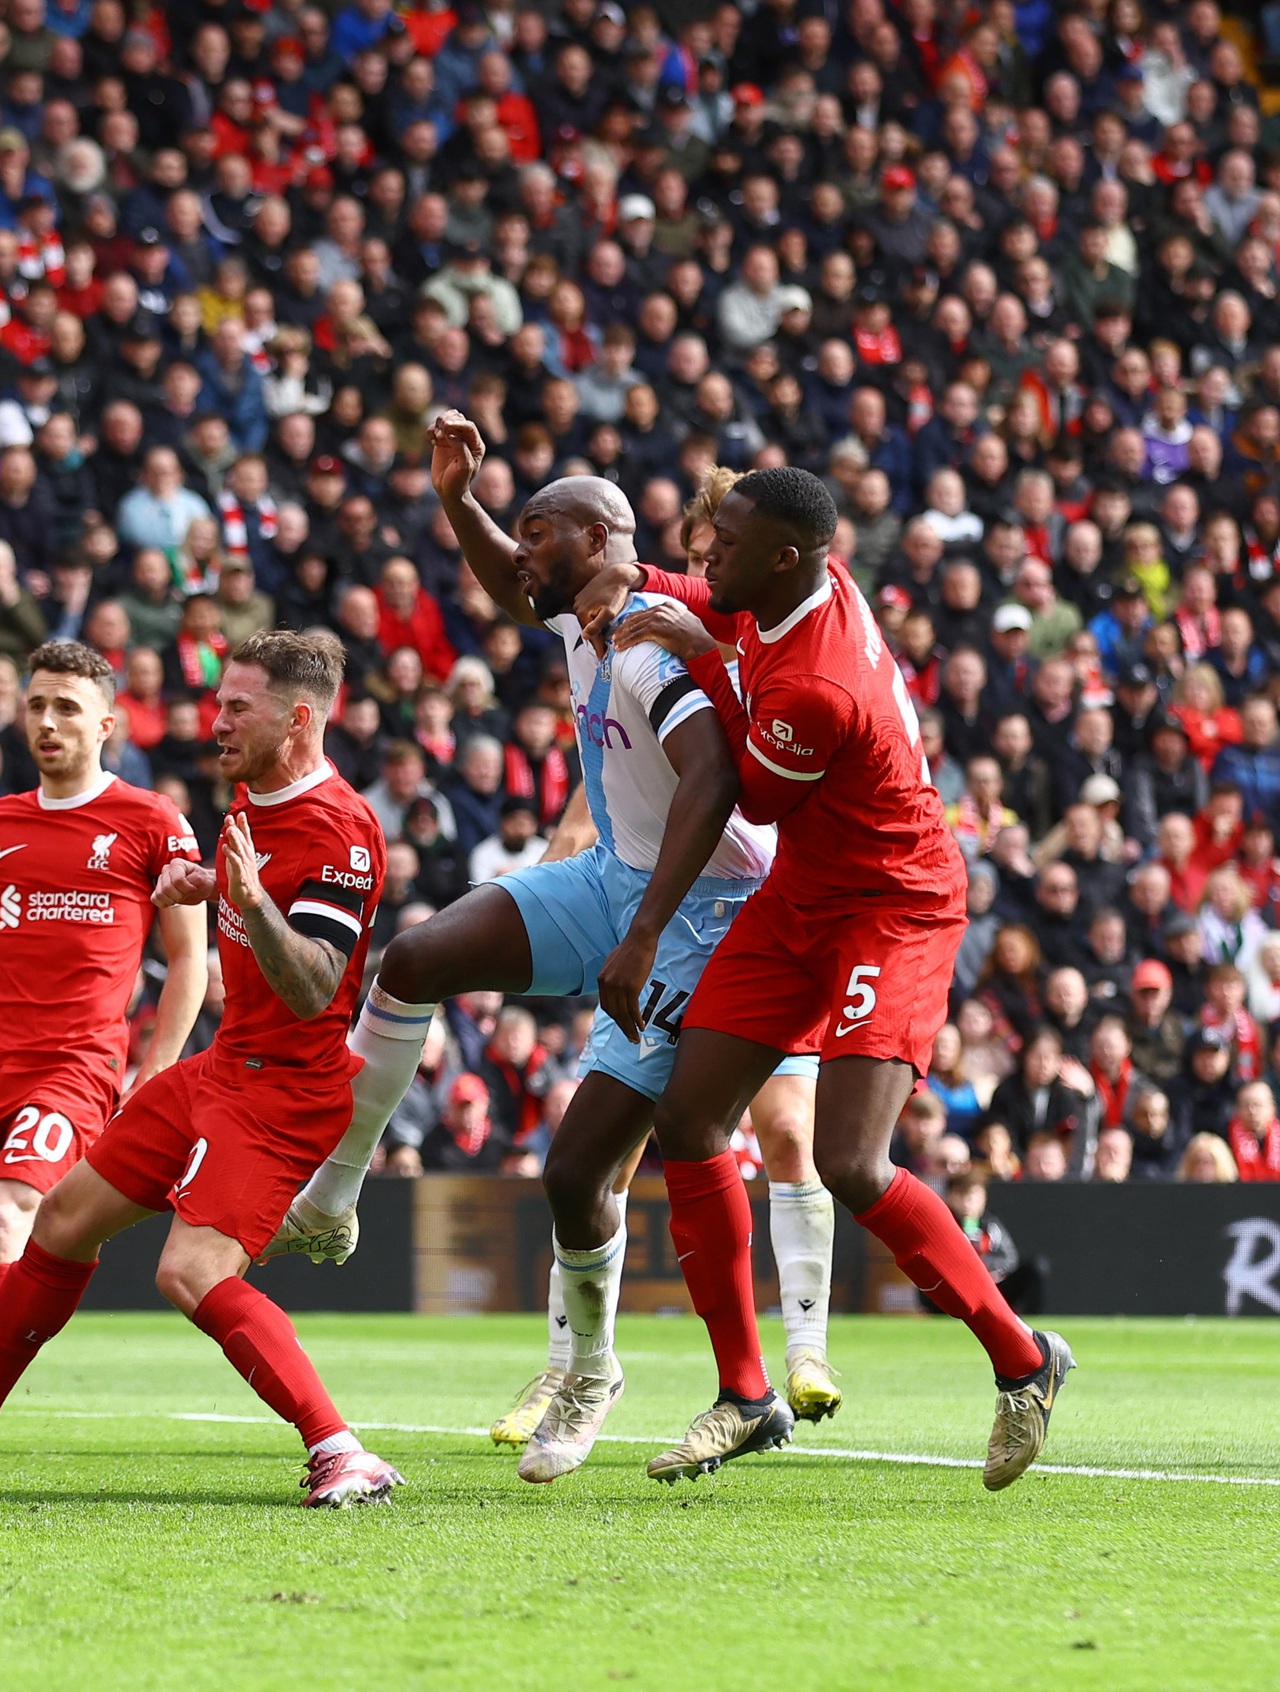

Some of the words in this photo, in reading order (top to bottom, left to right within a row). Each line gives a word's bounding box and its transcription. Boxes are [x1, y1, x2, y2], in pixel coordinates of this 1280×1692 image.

[26, 905, 114, 924] chartered
[28, 890, 110, 908] standard
[640, 978, 690, 1047] 14
[842, 964, 881, 1020] 5
[3, 1106, 74, 1163] 20
